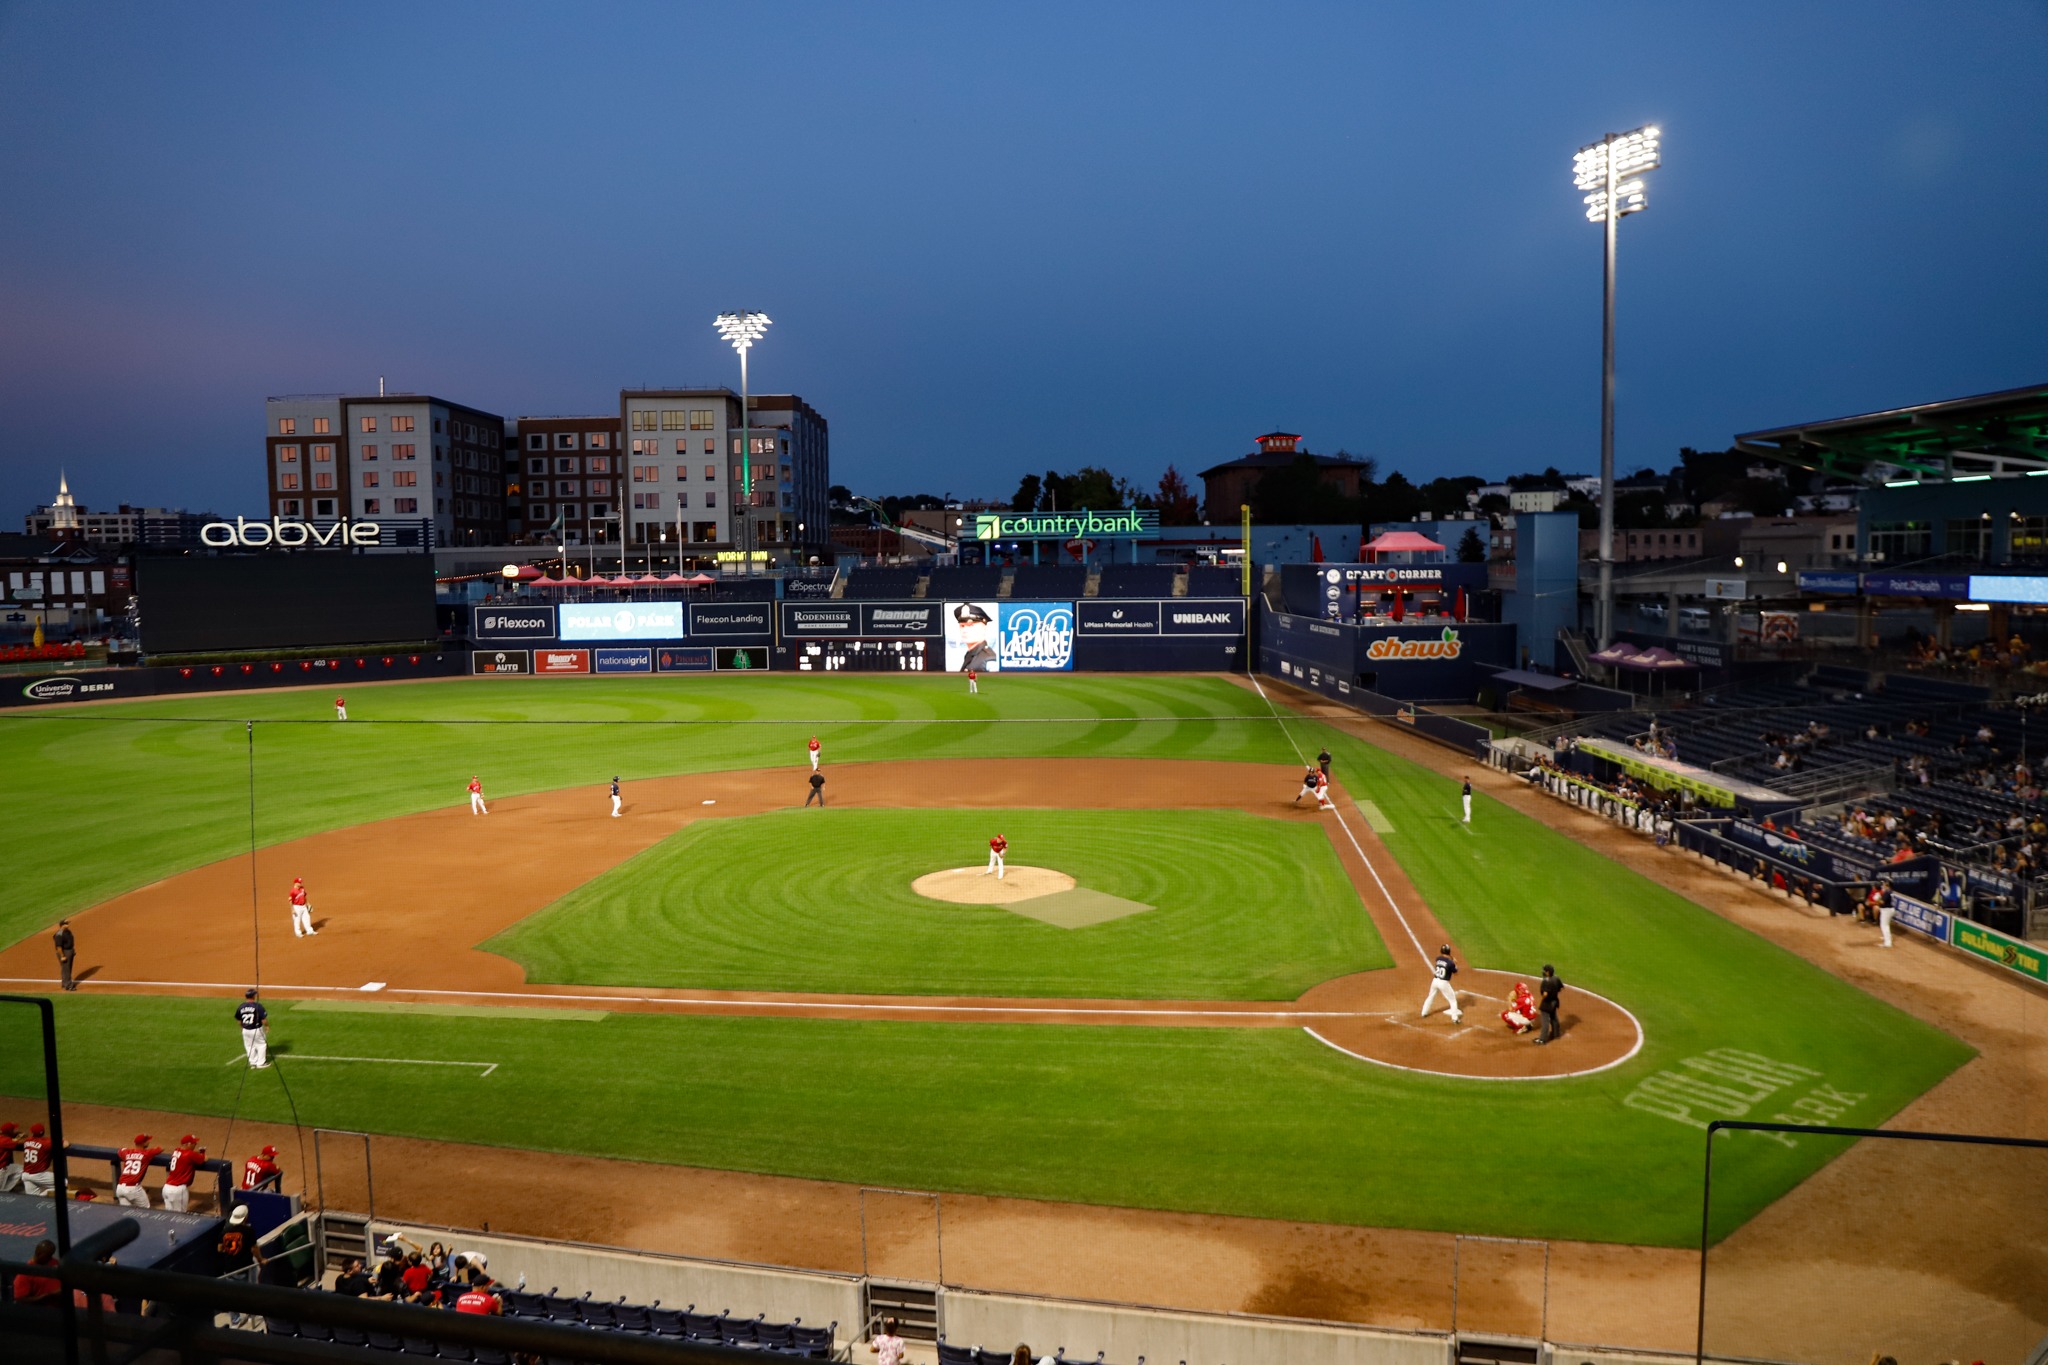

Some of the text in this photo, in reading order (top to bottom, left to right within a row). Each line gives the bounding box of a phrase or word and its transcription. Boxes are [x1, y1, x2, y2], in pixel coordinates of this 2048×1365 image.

[1001, 510, 1143, 539] countrybank
[200, 515, 380, 547] abbvie
[1399, 570, 1442, 579] CORNER
[799, 581, 832, 592] Spectru
[697, 614, 763, 624] Flexcon Landing
[794, 611, 851, 621] RODENHISER
[872, 609, 930, 620] Diamond
[1173, 613, 1231, 623] UNIBANK
[568, 615, 674, 628] POLAR PARK
[313, 659, 326, 667] 403
[599, 655, 648, 667] nationalgrid
[35, 683, 74, 693] University
[80, 683, 114, 692] BERM
[2018, 953, 2039, 973] TIRE
[242, 1013, 255, 1025] 27
[24, 1149, 38, 1163] 36
[123, 1160, 142, 1175] 29
[169, 1157, 177, 1171] 8
[245, 1170, 256, 1186] 11
